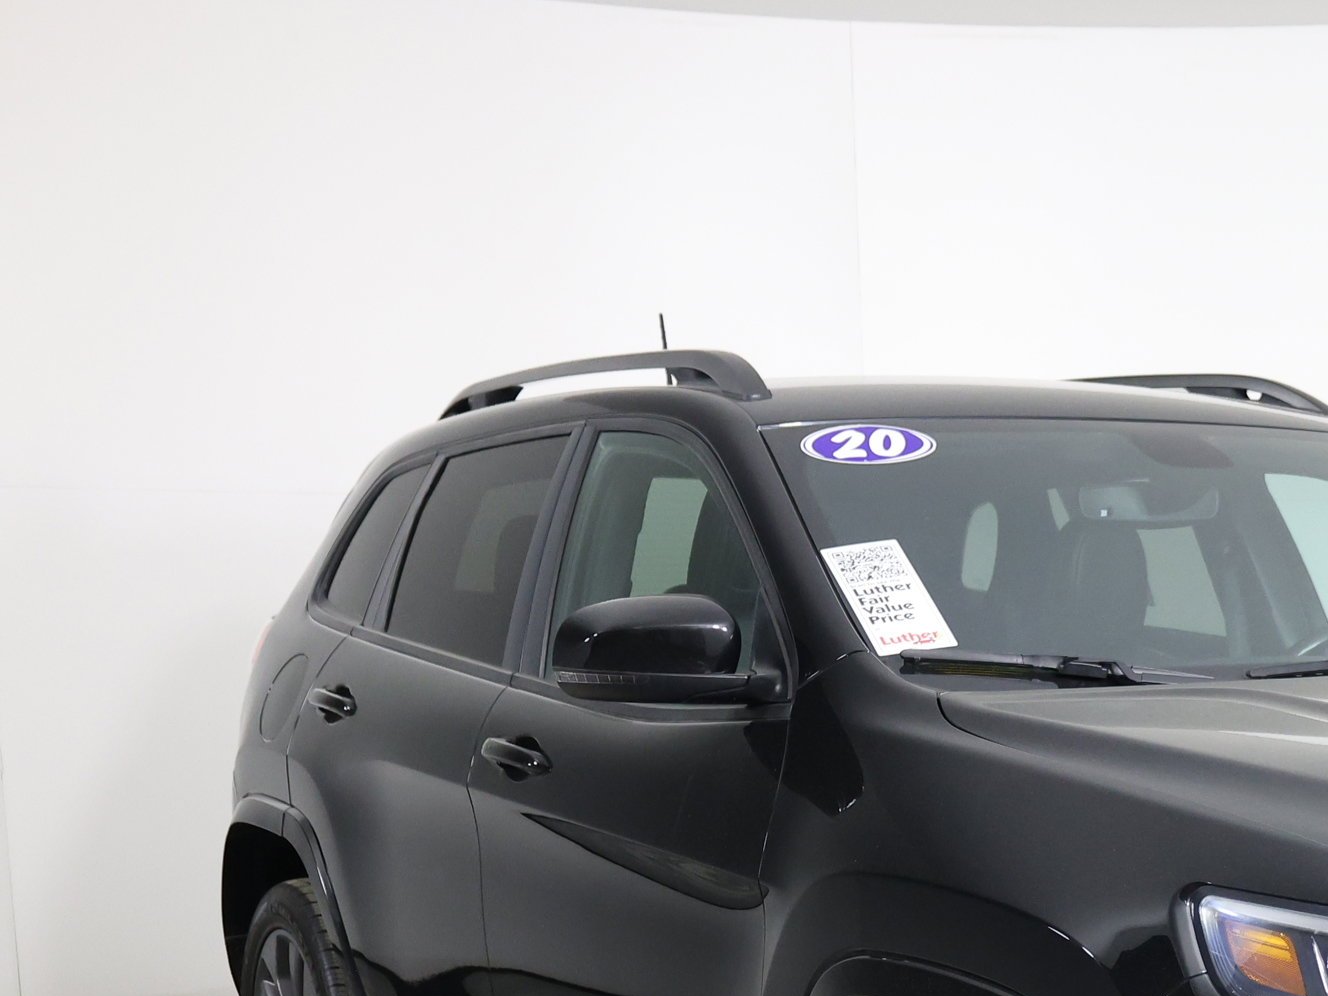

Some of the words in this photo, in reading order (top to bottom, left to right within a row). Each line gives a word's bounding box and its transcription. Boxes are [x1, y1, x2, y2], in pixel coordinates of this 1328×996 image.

[830, 428, 906, 460] 20
[853, 583, 911, 597] Luther
[858, 594, 890, 606] Fair
[862, 603, 915, 614] Value
[868, 612, 915, 625] Price
[880, 631, 938, 645] Luther
